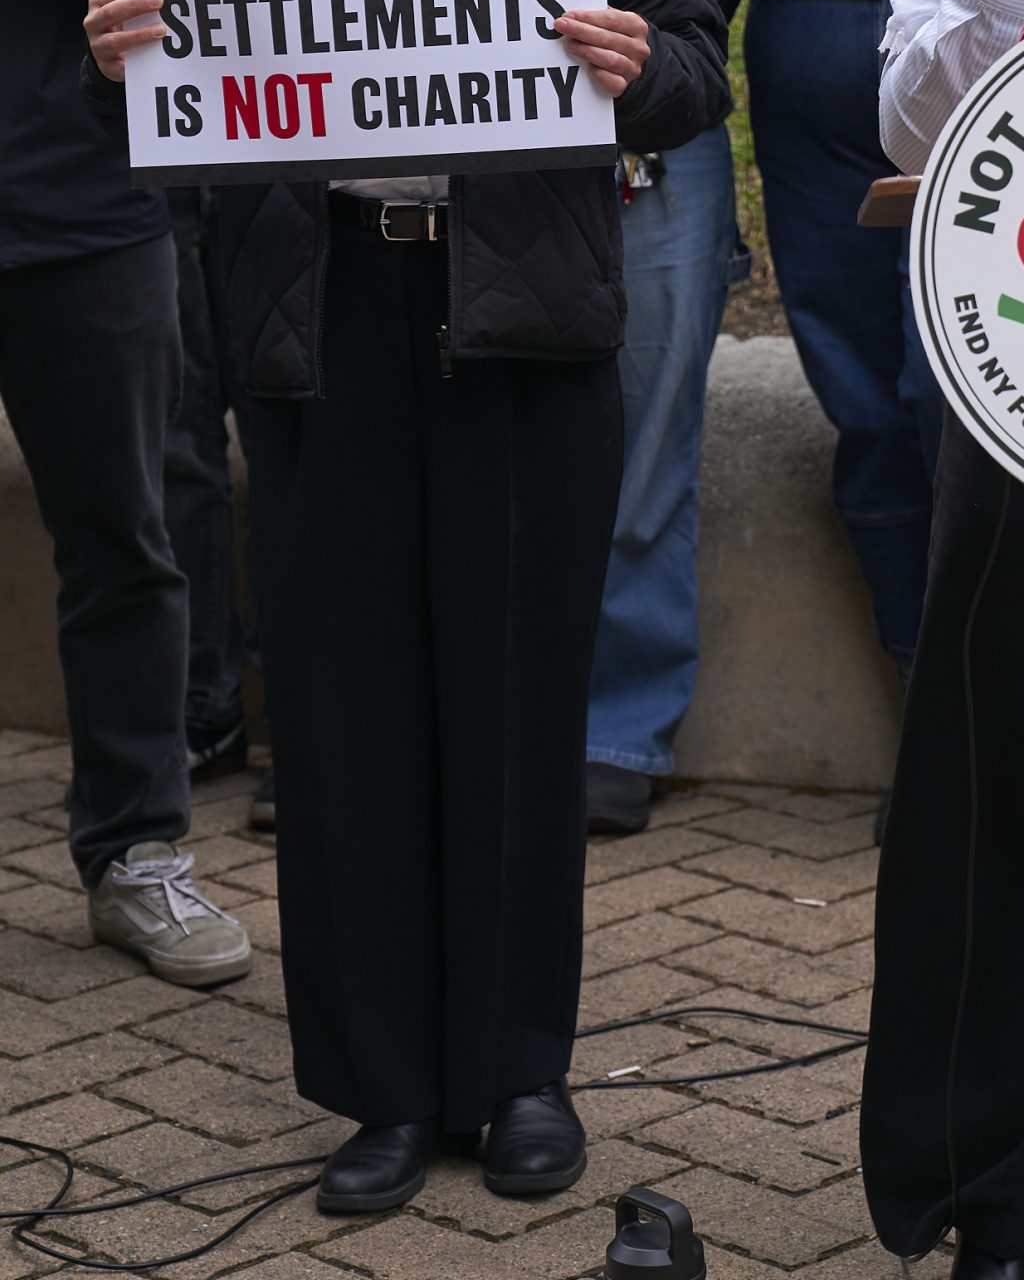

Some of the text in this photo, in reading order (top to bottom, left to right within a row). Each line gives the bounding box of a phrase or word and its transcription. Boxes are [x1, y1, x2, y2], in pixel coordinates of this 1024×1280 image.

[154, 66, 579, 140] IS NOT CHARITY
[954, 293, 990, 355] END
[977, 356, 1017, 396] NY
